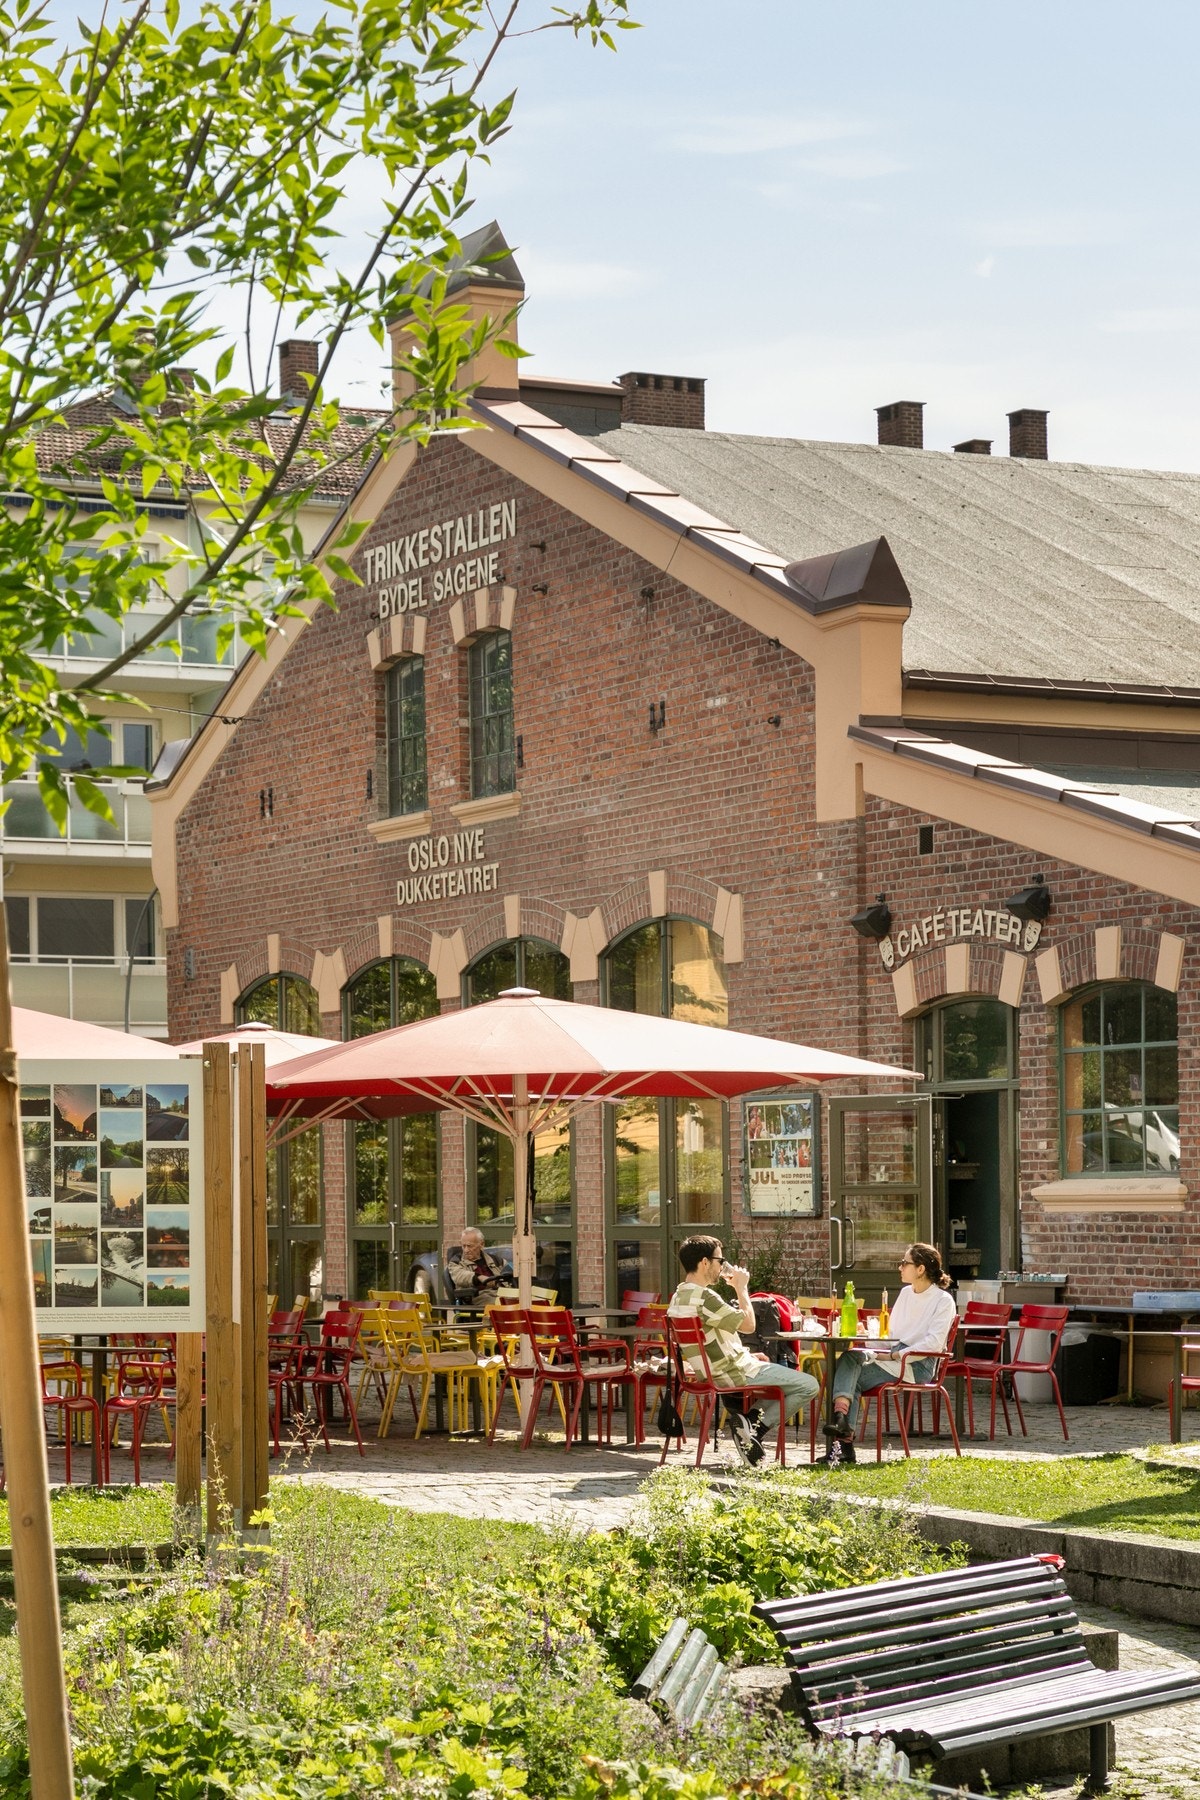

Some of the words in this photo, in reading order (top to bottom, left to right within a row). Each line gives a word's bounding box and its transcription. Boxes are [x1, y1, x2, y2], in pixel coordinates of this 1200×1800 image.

[363, 498, 517, 586] TRIKKESTALLEN
[379, 577, 428, 619] BYDEL
[433, 552, 499, 602] SAGENE
[408, 835, 450, 873] OSLO
[453, 828, 485, 864] NYE
[397, 862, 500, 906] DUKKETEATRET
[751, 1171, 779, 1185] JUL
